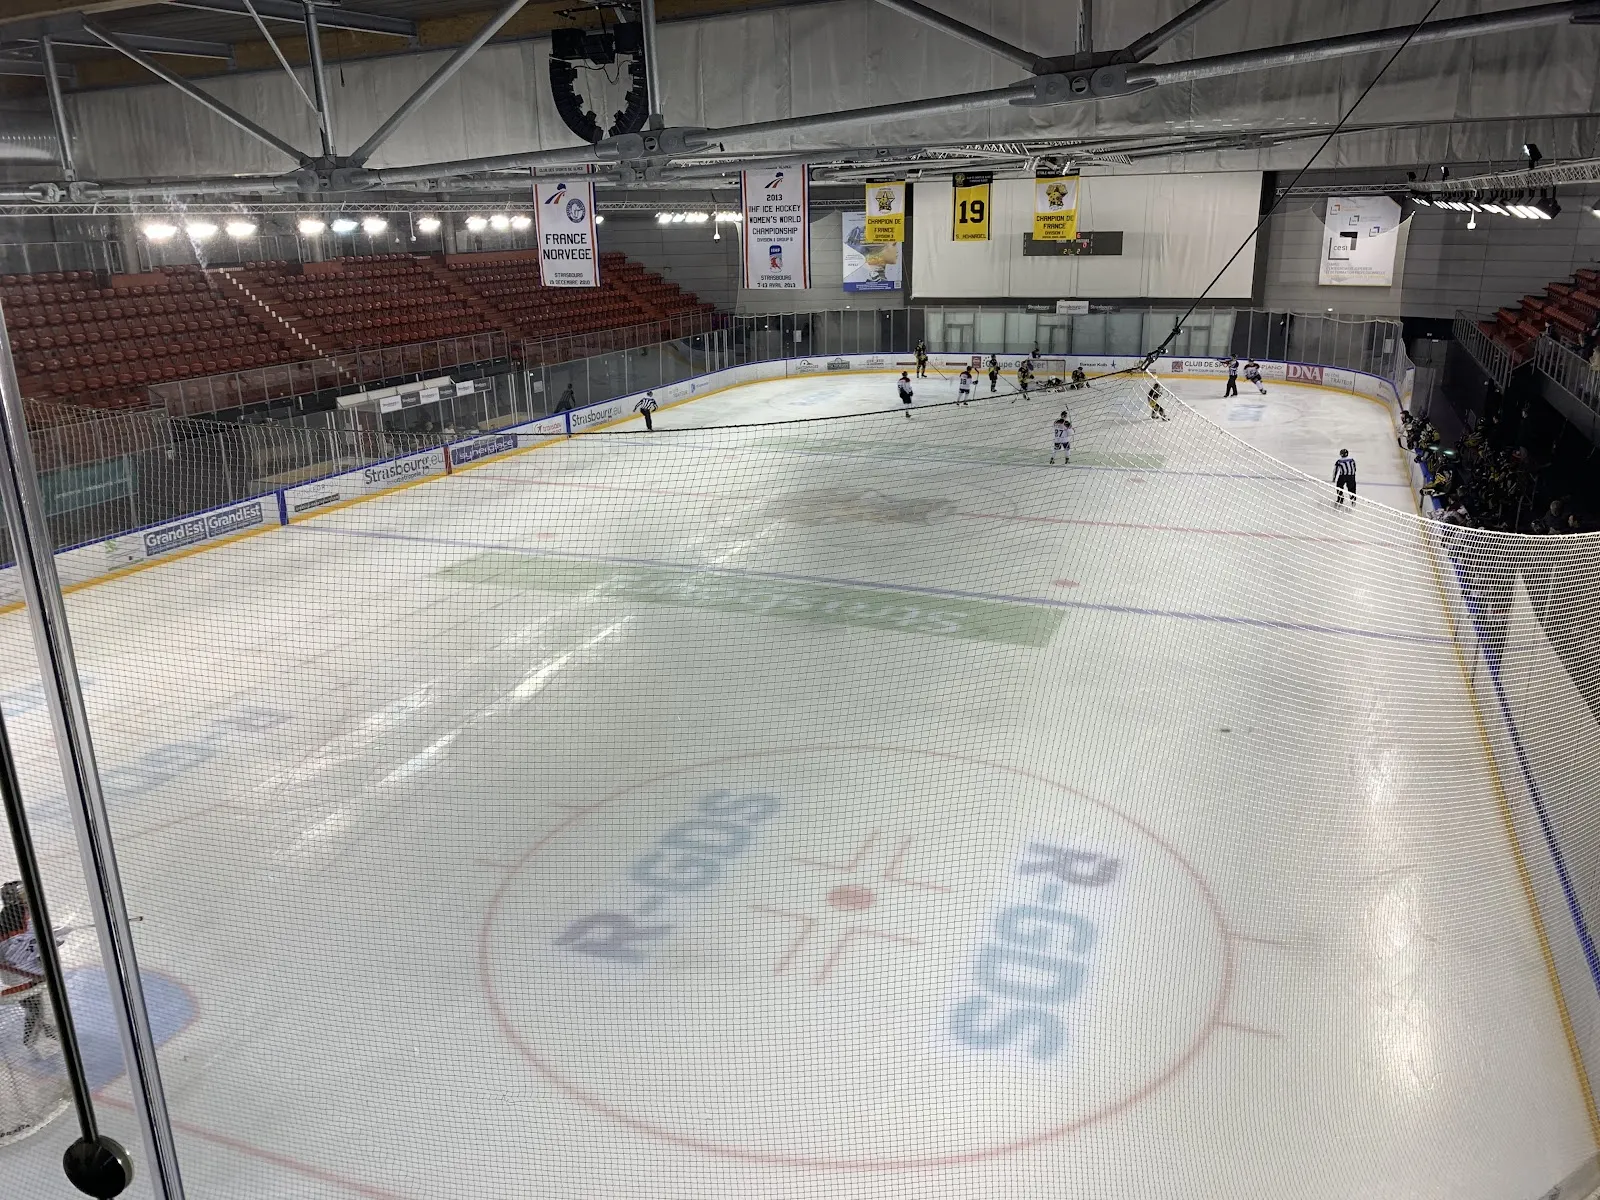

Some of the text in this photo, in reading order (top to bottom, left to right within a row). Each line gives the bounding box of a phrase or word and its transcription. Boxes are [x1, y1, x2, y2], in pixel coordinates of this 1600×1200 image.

[775, 204, 800, 212] HOCKEY
[959, 200, 984, 223] 19
[546, 233, 587, 244] FRANCE
[543, 249, 592, 260] NORVEGE
[1287, 364, 1322, 380] DNA
[460, 438, 513, 460] synerglace
[365, 454, 444, 484] Strasbourg.eu
[948, 842, 1121, 1062] R-GDS
